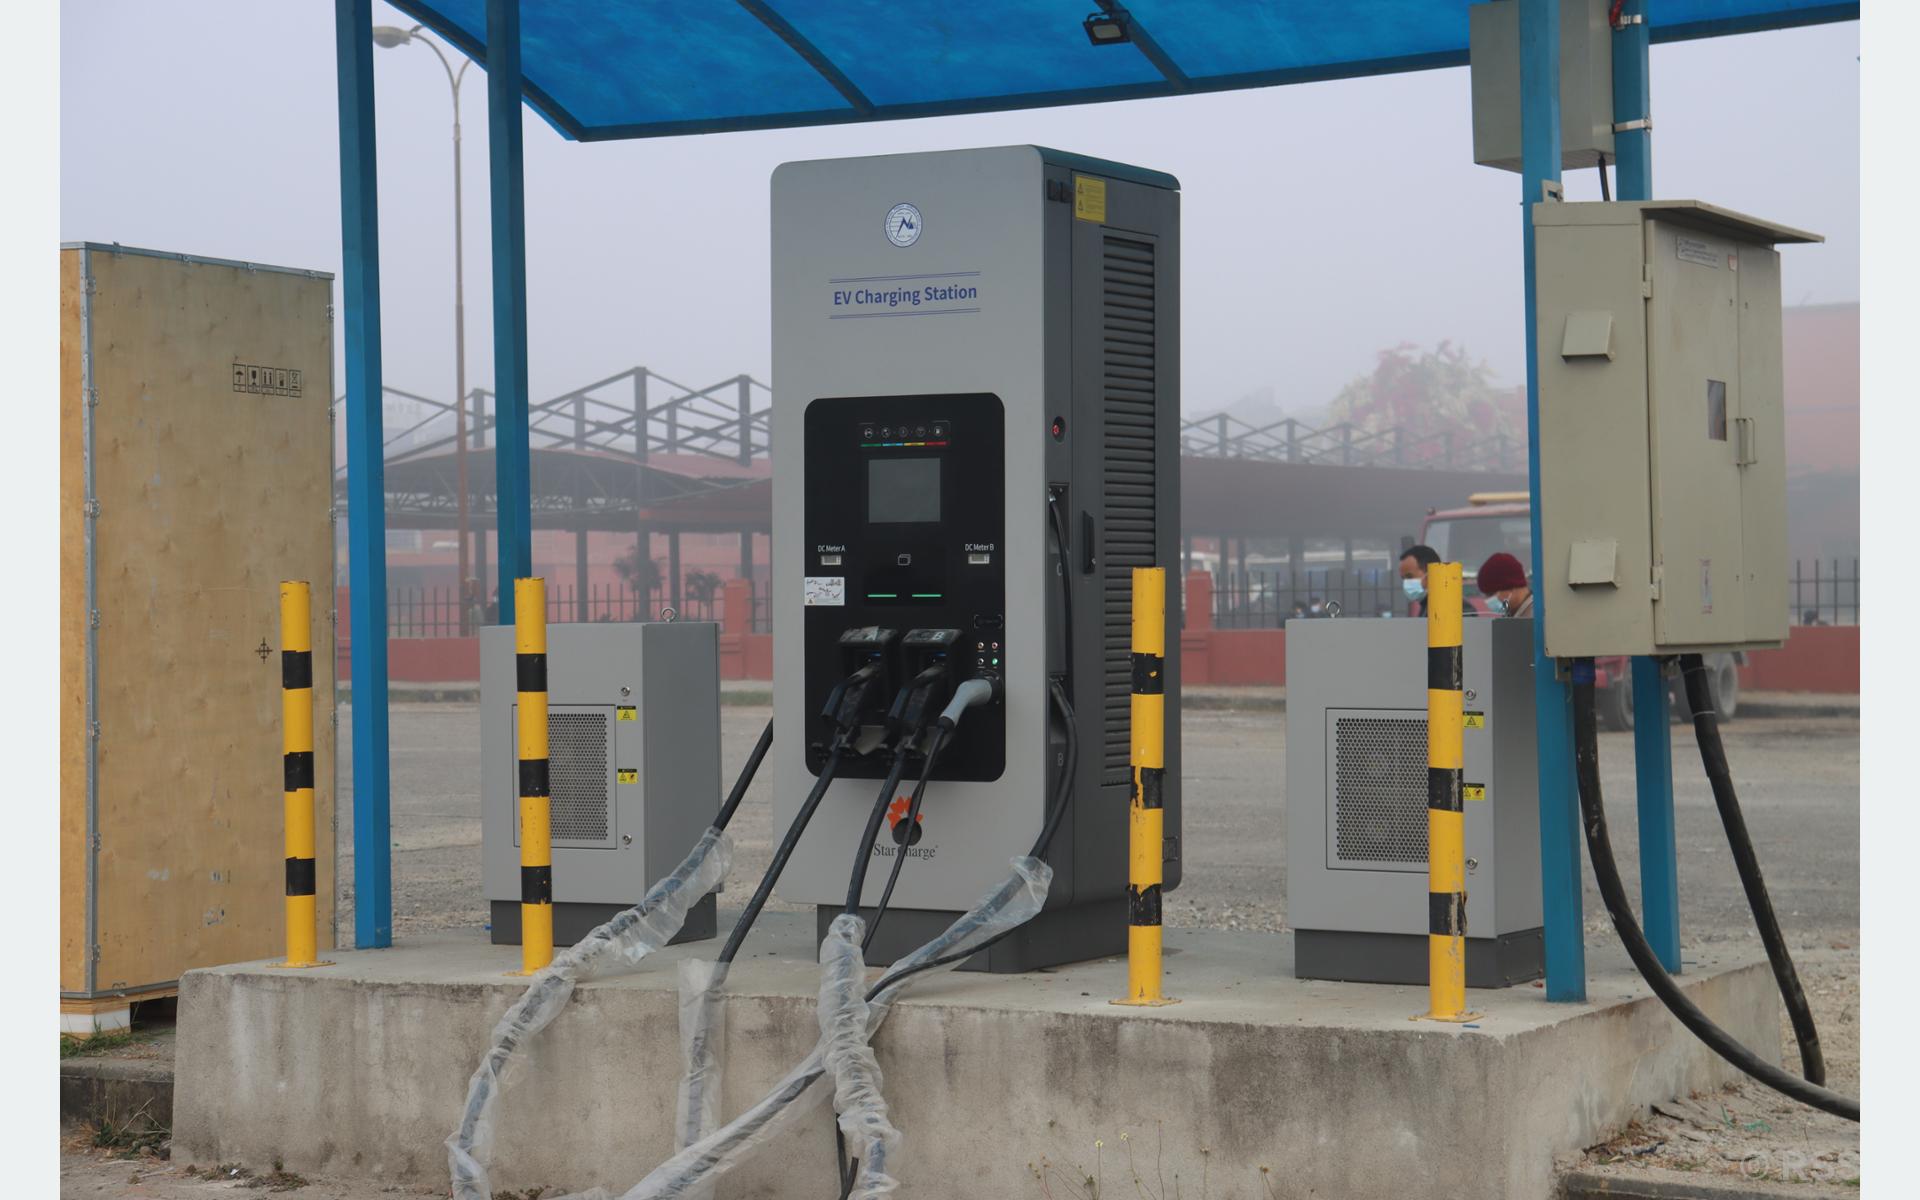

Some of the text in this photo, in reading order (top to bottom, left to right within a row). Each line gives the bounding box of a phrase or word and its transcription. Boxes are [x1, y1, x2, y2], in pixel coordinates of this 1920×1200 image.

[834, 284, 977, 307] EV Charging Station
[817, 544, 825, 552] DC
[826, 544, 841, 552] Meter
[965, 543, 973, 551] DC
[973, 543, 989, 551] Meter
[873, 843, 896, 857] Star
